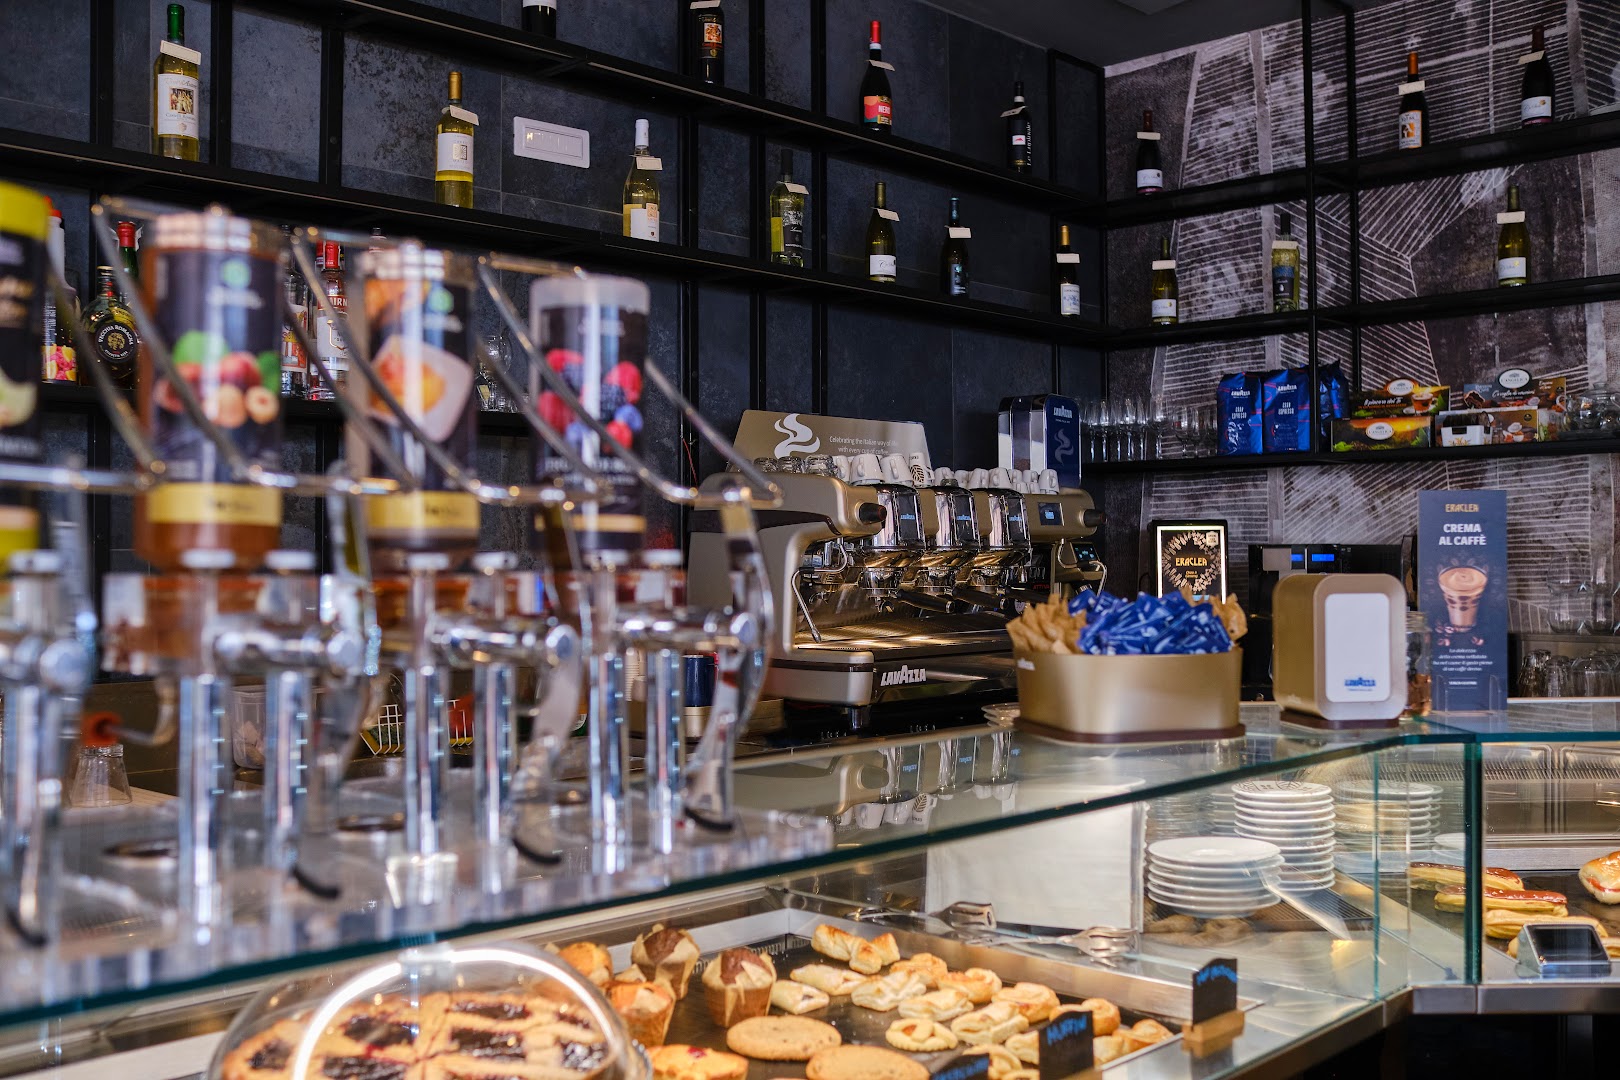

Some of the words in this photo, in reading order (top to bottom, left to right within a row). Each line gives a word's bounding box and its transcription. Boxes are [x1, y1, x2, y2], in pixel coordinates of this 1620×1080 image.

[114, 325, 134, 345] ROMAGNA
[1231, 388, 1251, 396] LAVAZZA
[829, 436, 855, 446] Celebrating
[863, 438, 876, 446] Italian
[1445, 503, 1479, 513] ERACLEA
[1443, 523, 1482, 533] CREMA
[1438, 536, 1453, 546] AL
[1453, 534, 1487, 546] CAFFÈ
[1175, 557, 1208, 566] ERACLEA
[880, 664, 926, 687] LAVAZZA
